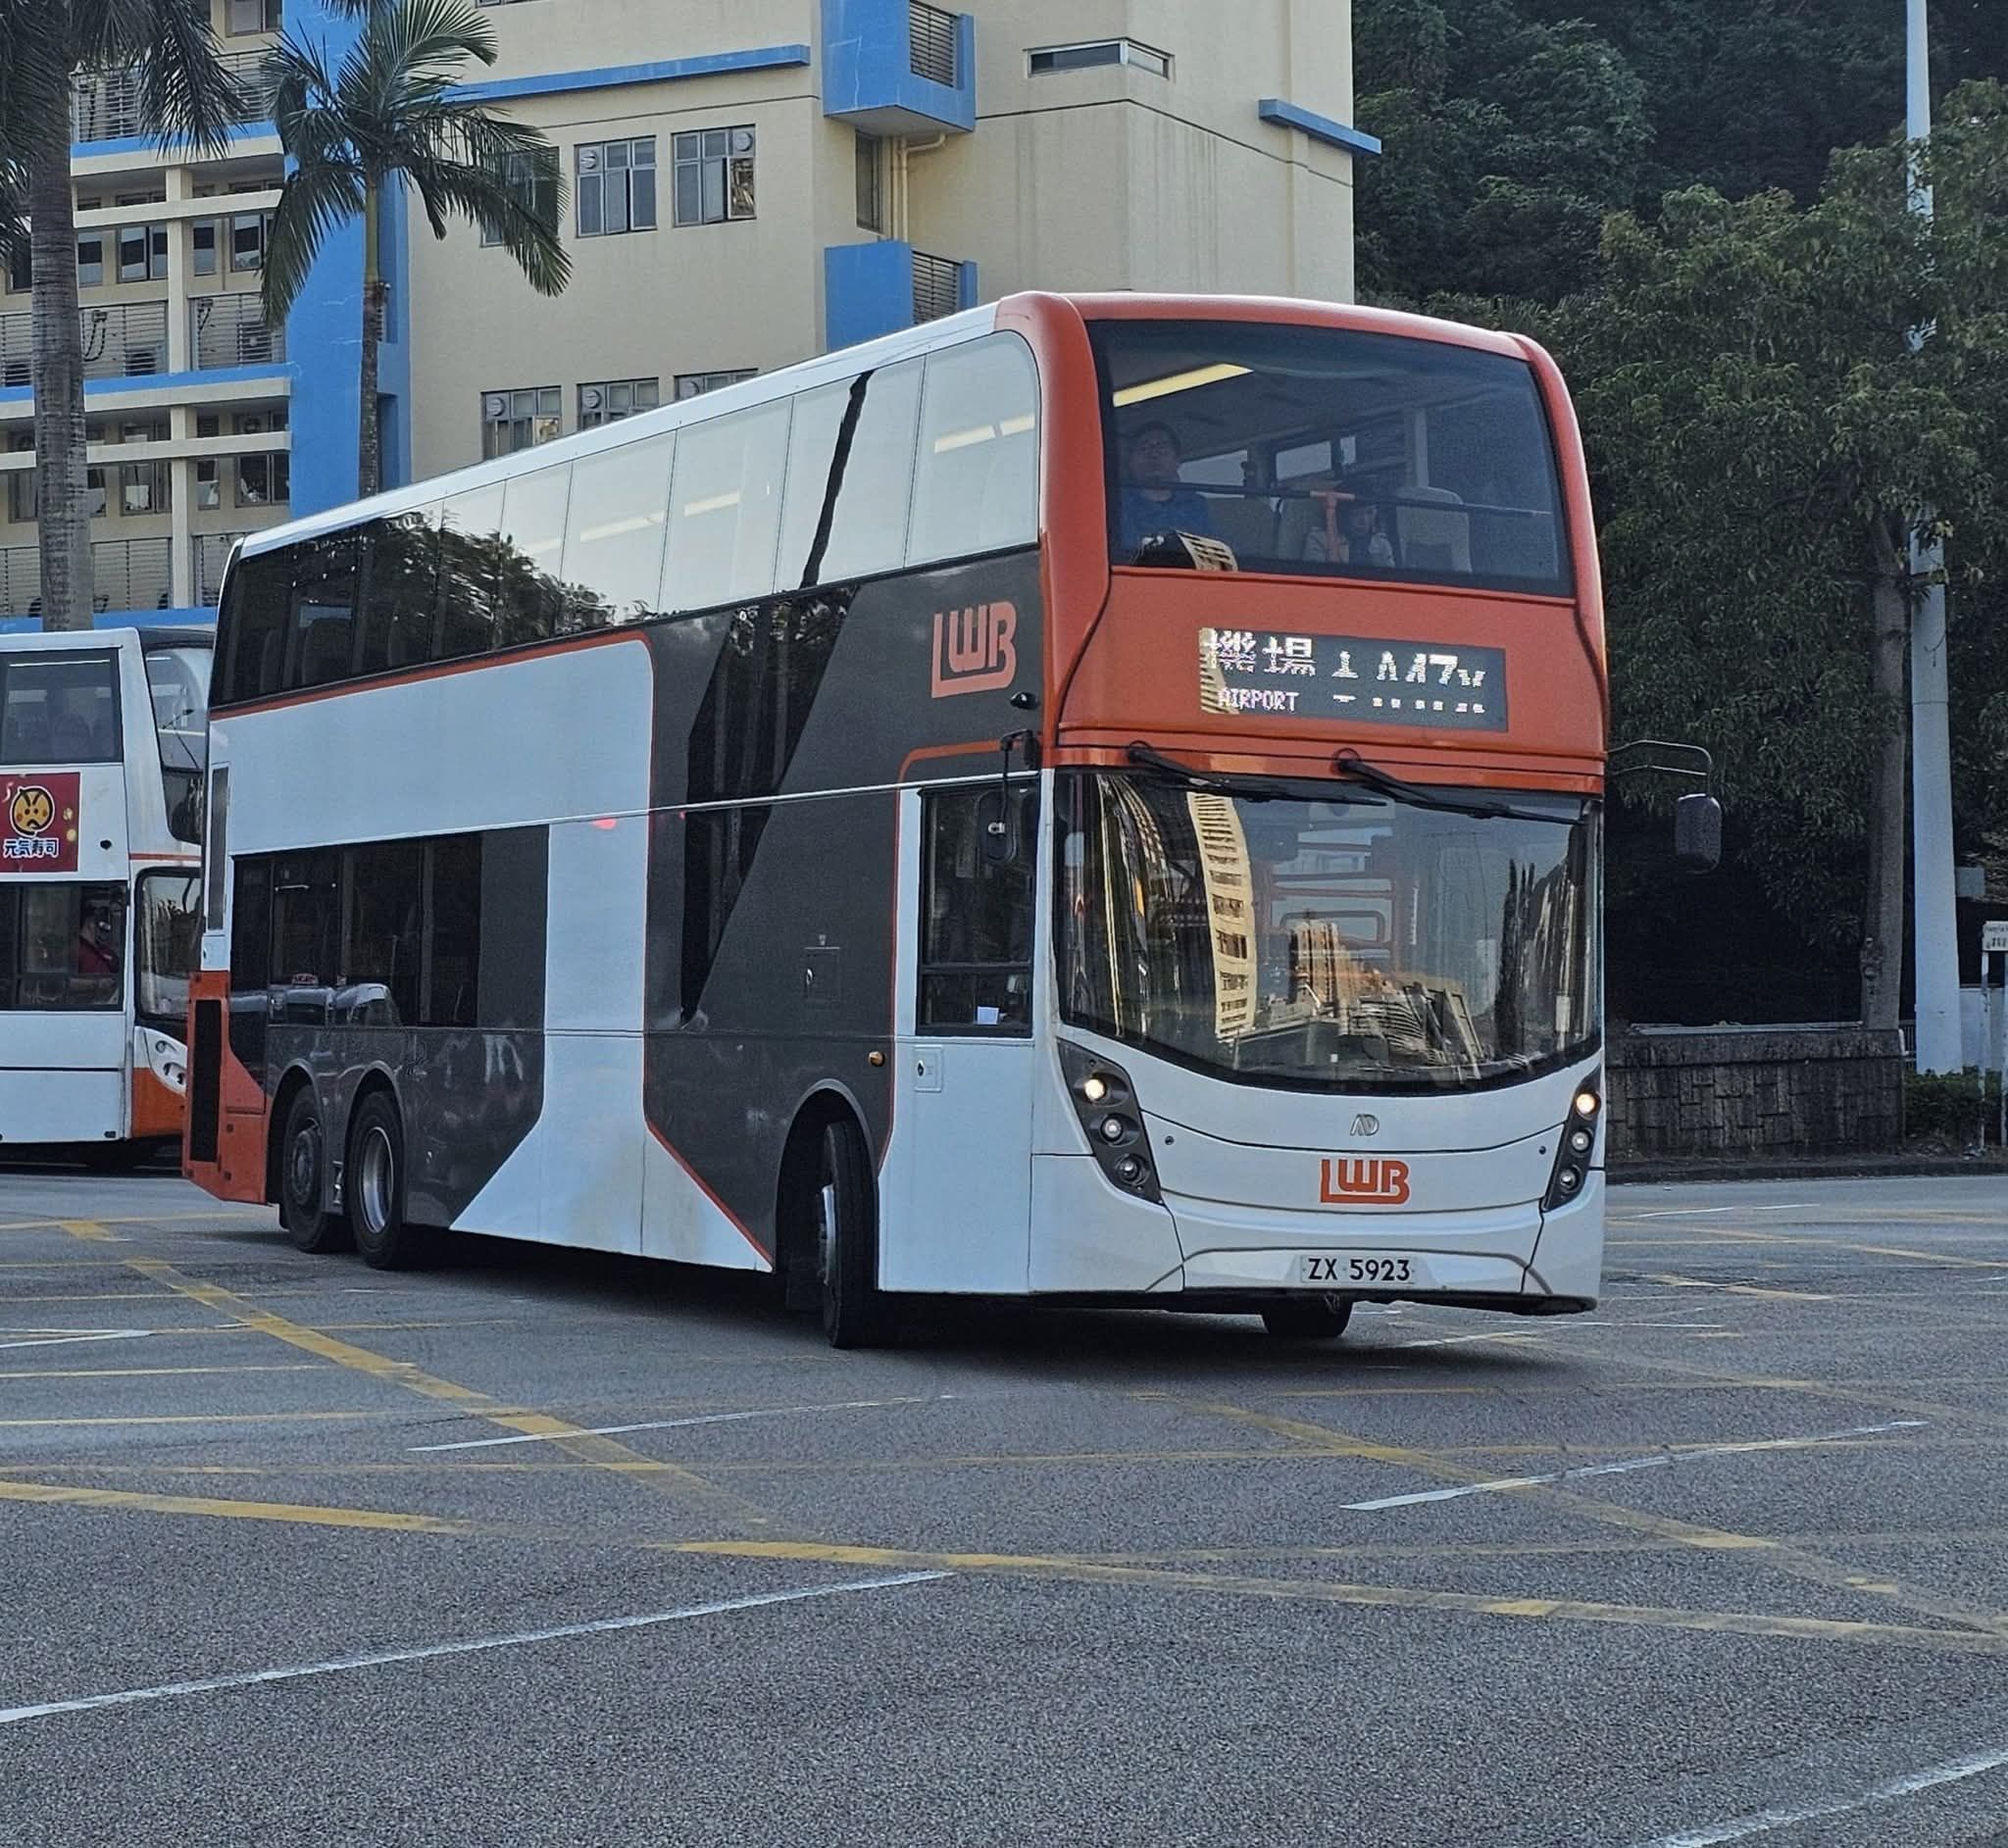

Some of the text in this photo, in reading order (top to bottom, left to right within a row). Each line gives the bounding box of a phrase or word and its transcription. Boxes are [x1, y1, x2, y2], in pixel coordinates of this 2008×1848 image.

[931, 601, 1017, 698] LWB
[1219, 687, 1300, 712] AIRPORT
[1320, 1159, 1410, 1205] LWB
[1308, 1258, 1410, 1281] ZX 5923
